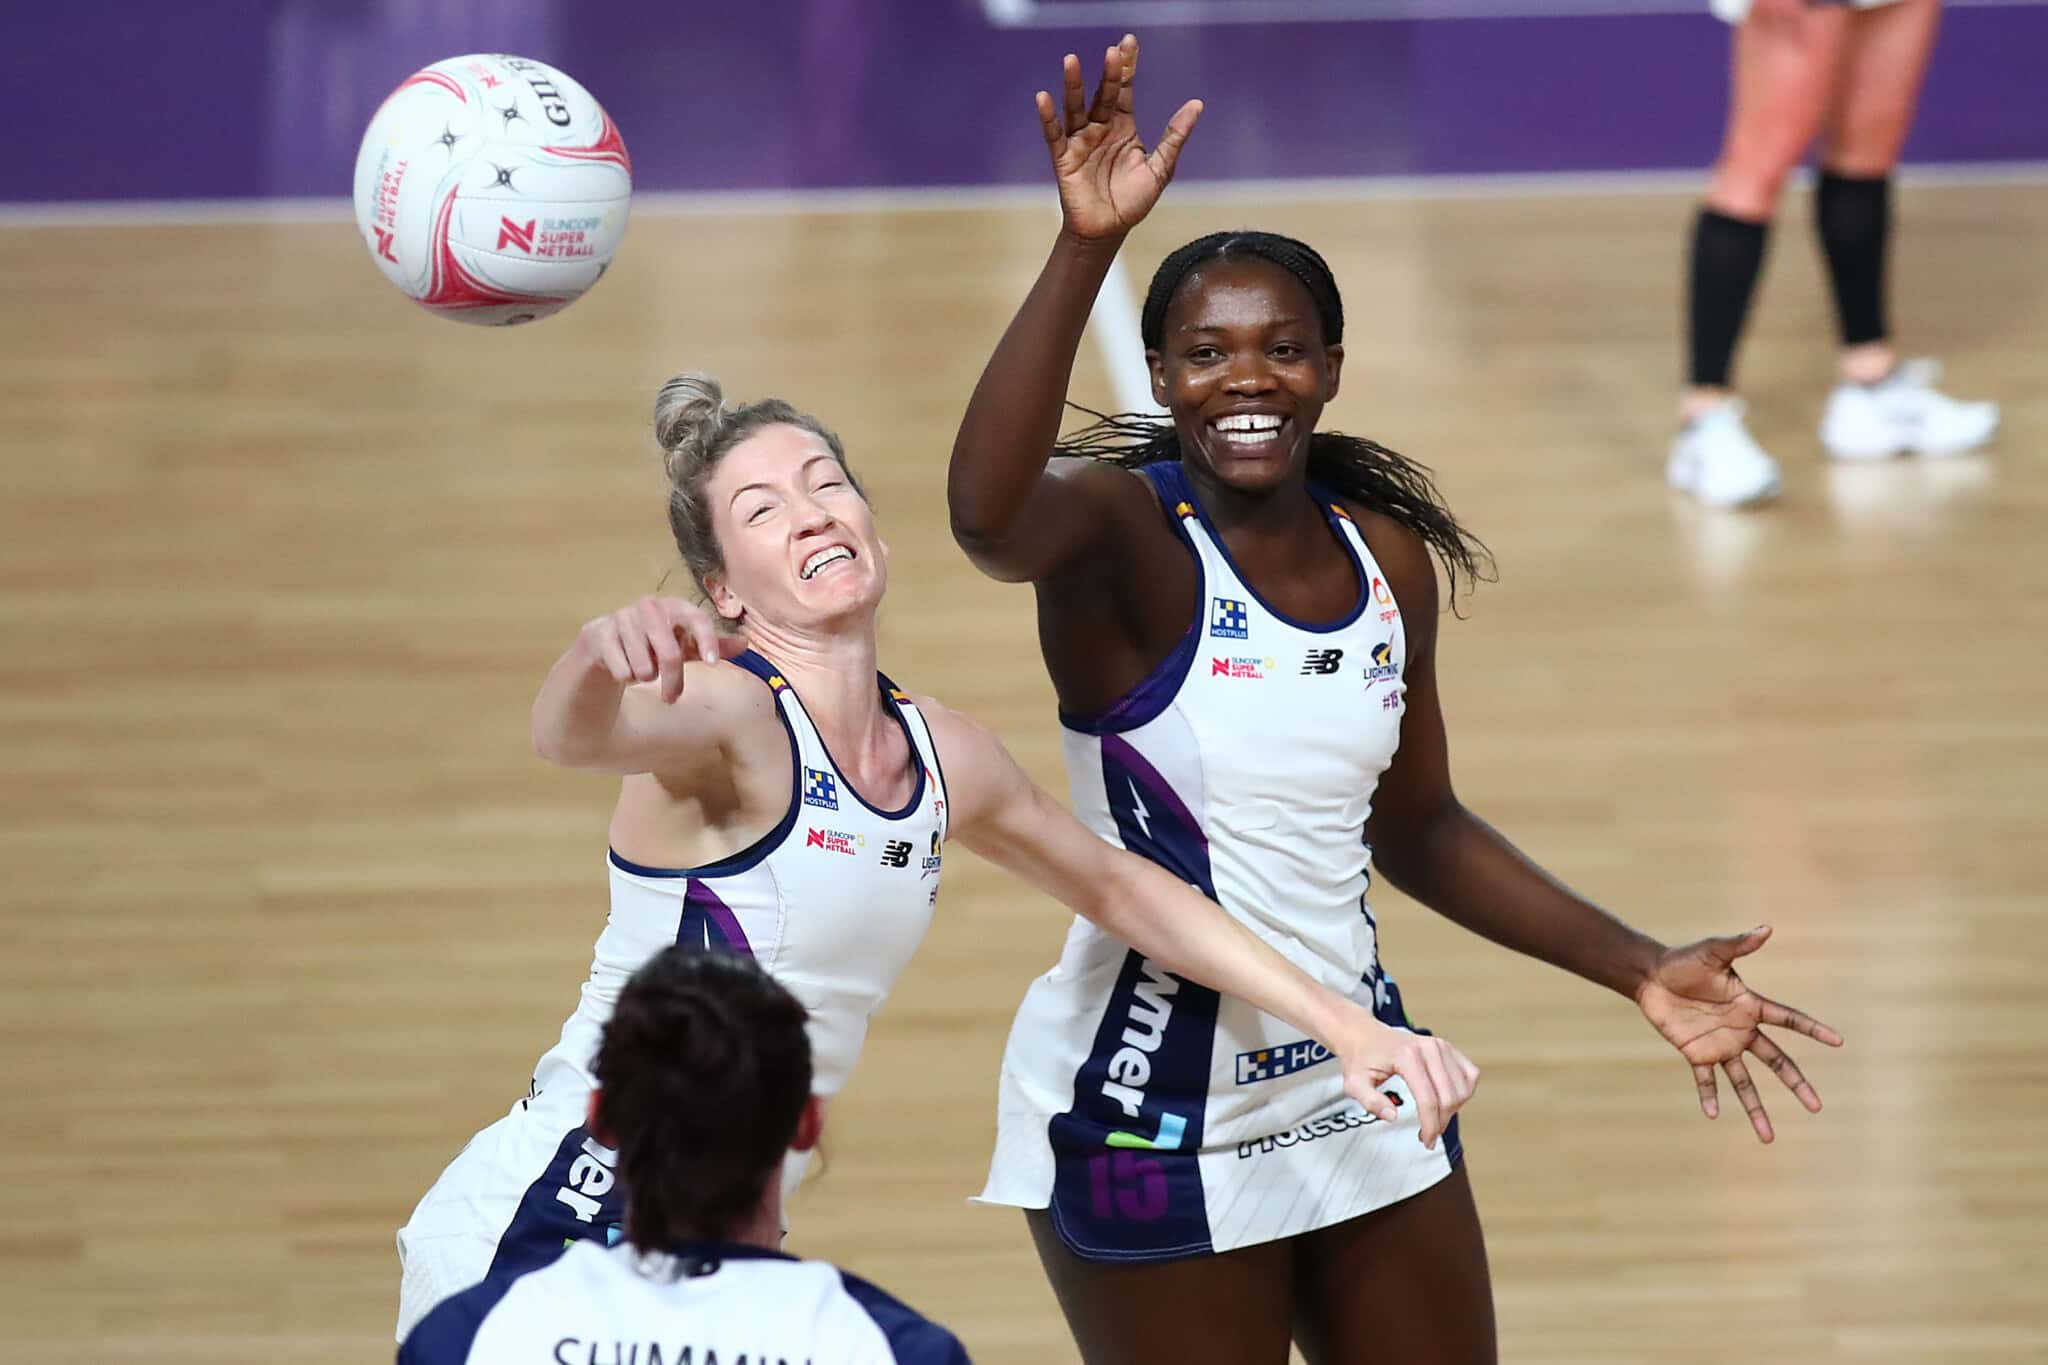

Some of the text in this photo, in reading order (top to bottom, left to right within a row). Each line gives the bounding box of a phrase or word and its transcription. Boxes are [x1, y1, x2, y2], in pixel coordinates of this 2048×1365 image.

[539, 231, 585, 243] SUPER
[536, 244, 593, 257] NETBALL
[1212, 628, 1247, 638] HOSTPLUS
[1231, 671, 1264, 679] NETBALL
[806, 797, 837, 809] HOSTPLUS
[826, 836, 849, 847] SUPER
[825, 844, 857, 856] NETBALL
[1088, 1150, 1168, 1221] 15
